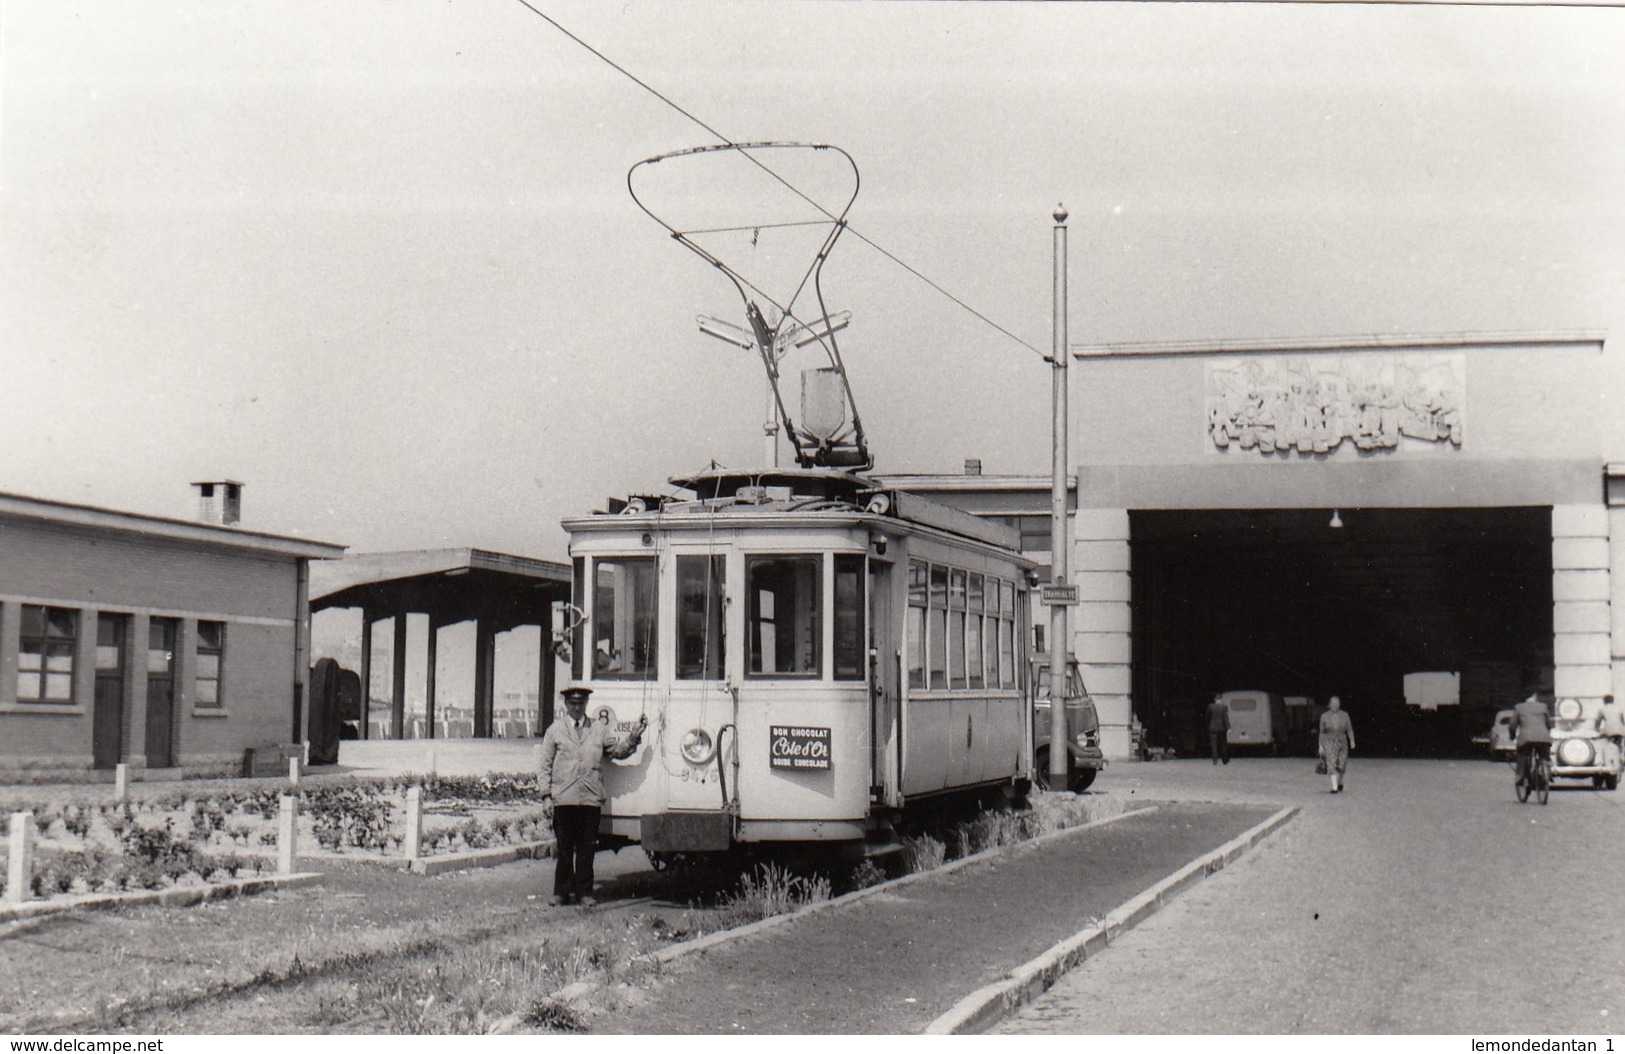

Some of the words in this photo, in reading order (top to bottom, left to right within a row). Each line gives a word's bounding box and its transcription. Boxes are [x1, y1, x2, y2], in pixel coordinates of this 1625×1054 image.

[599, 709, 609, 726] 8
[773, 728, 788, 737] BON
[791, 728, 828, 738] CHOCOLAT
